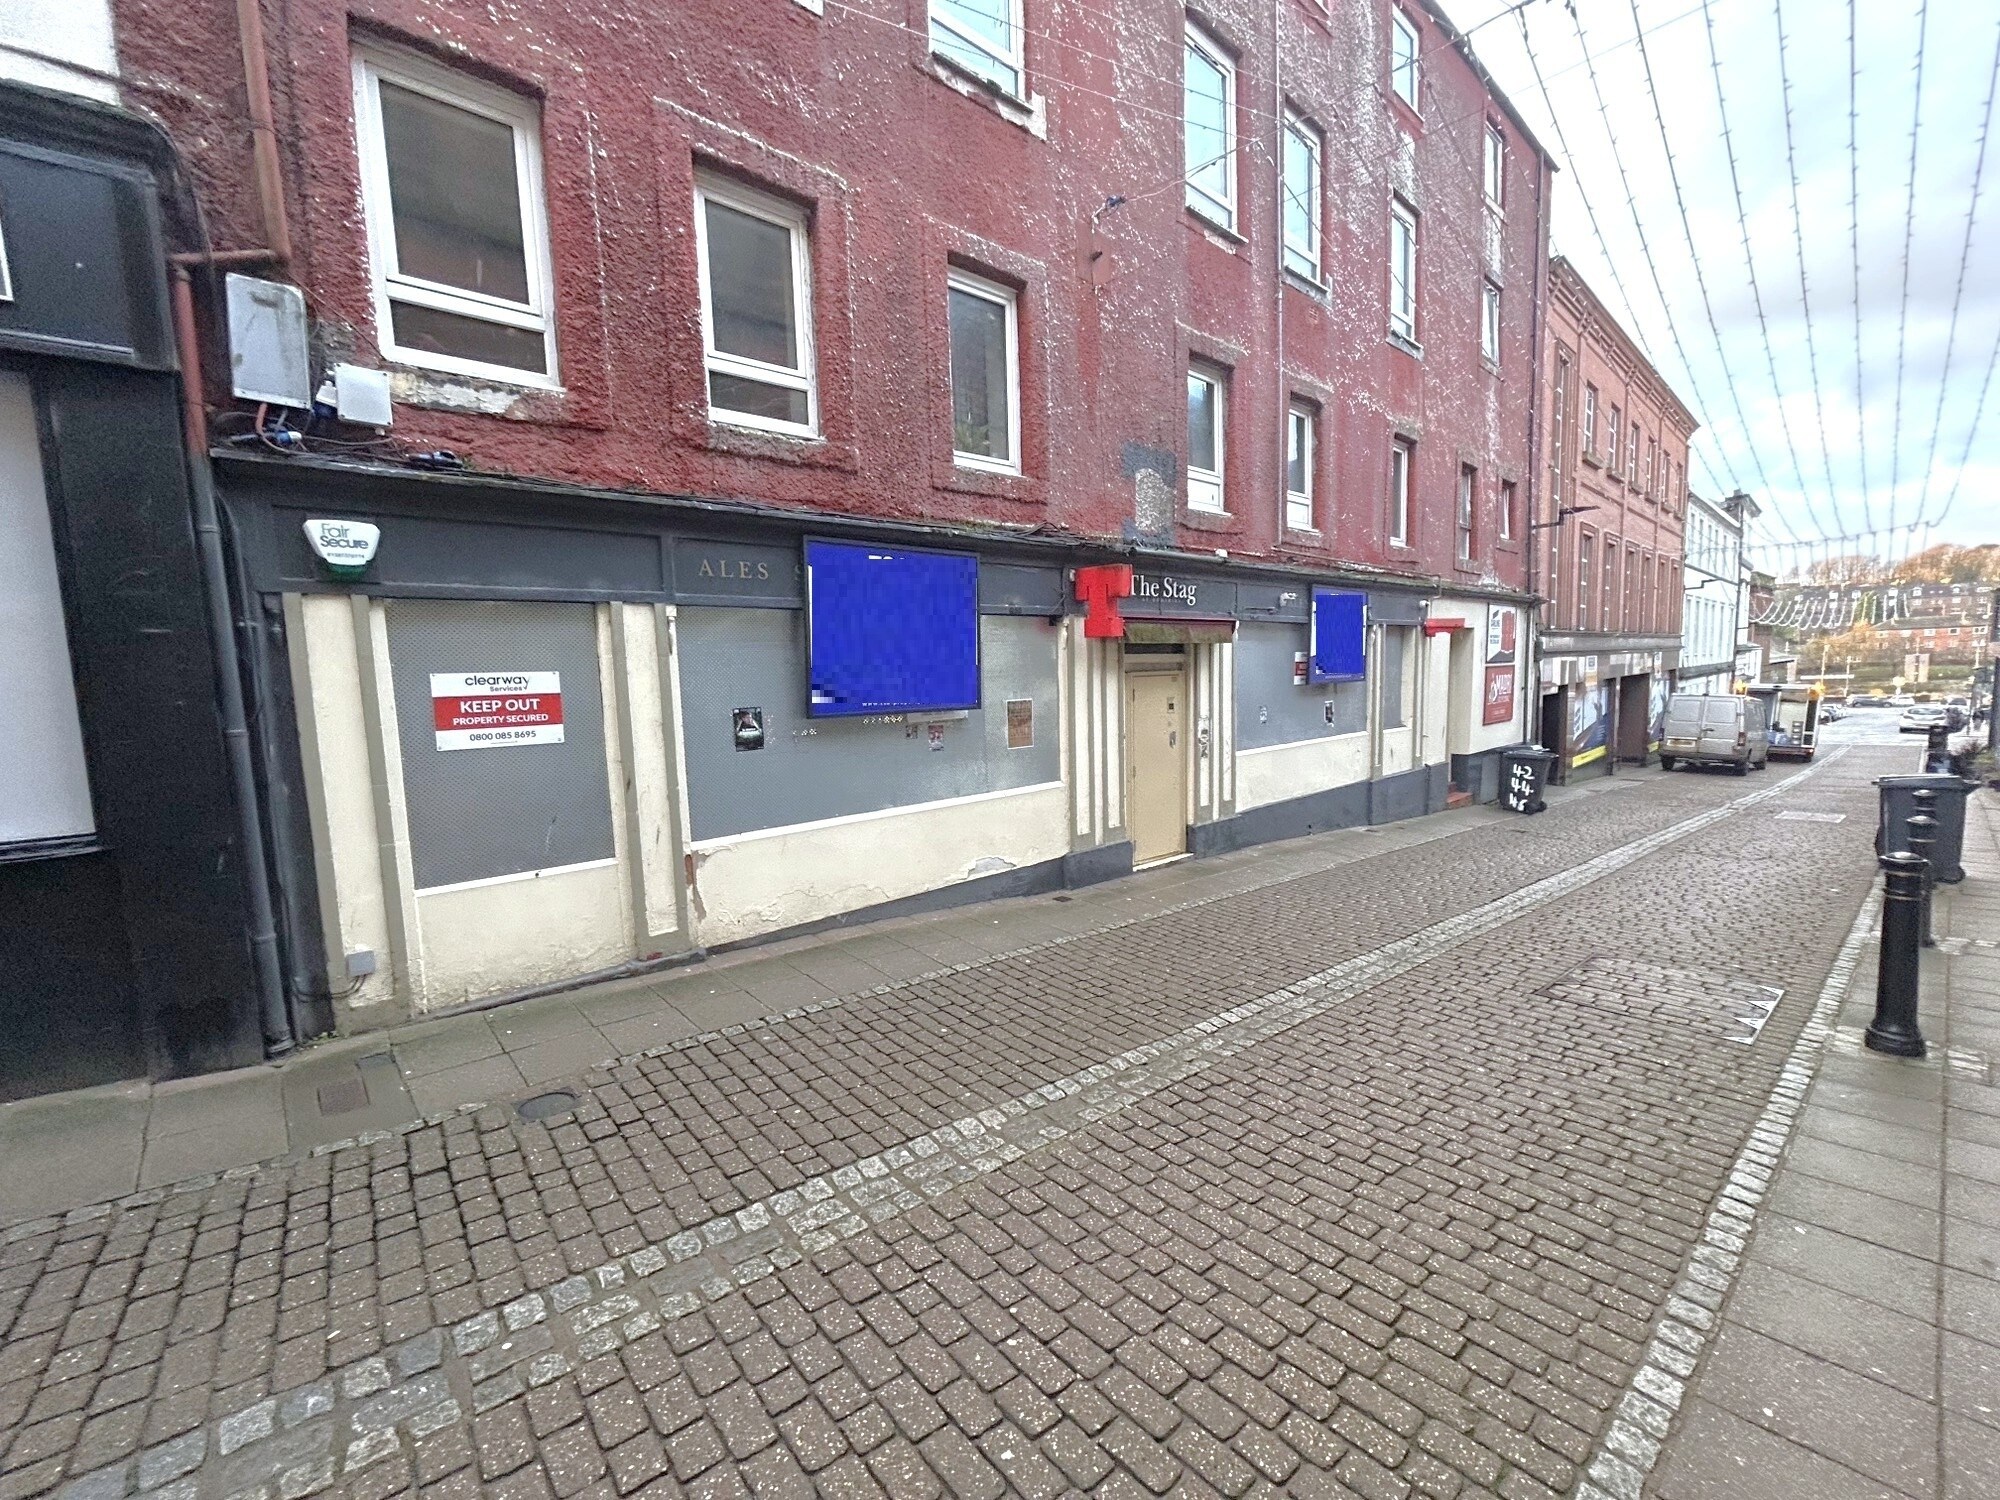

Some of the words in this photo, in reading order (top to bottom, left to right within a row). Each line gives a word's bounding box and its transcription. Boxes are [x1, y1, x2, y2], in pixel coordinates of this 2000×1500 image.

[321, 523, 350, 538] Fair
[320, 535, 369, 549] Secure
[699, 559, 769, 580] ALES
[1131, 574, 1160, 597] The
[1163, 576, 1197, 606] Stag
[465, 675, 530, 690] clearway
[460, 699, 502, 713] KEEP
[505, 698, 540, 711] OUT
[453, 715, 504, 725] PROPERTY
[506, 713, 549, 722] SECURED
[469, 733, 493, 741] 0800
[495, 732, 512, 740] 085
[514, 730, 537, 739] 8695
[1513, 763, 1535, 780] 42
[1511, 777, 1534, 796] 44
